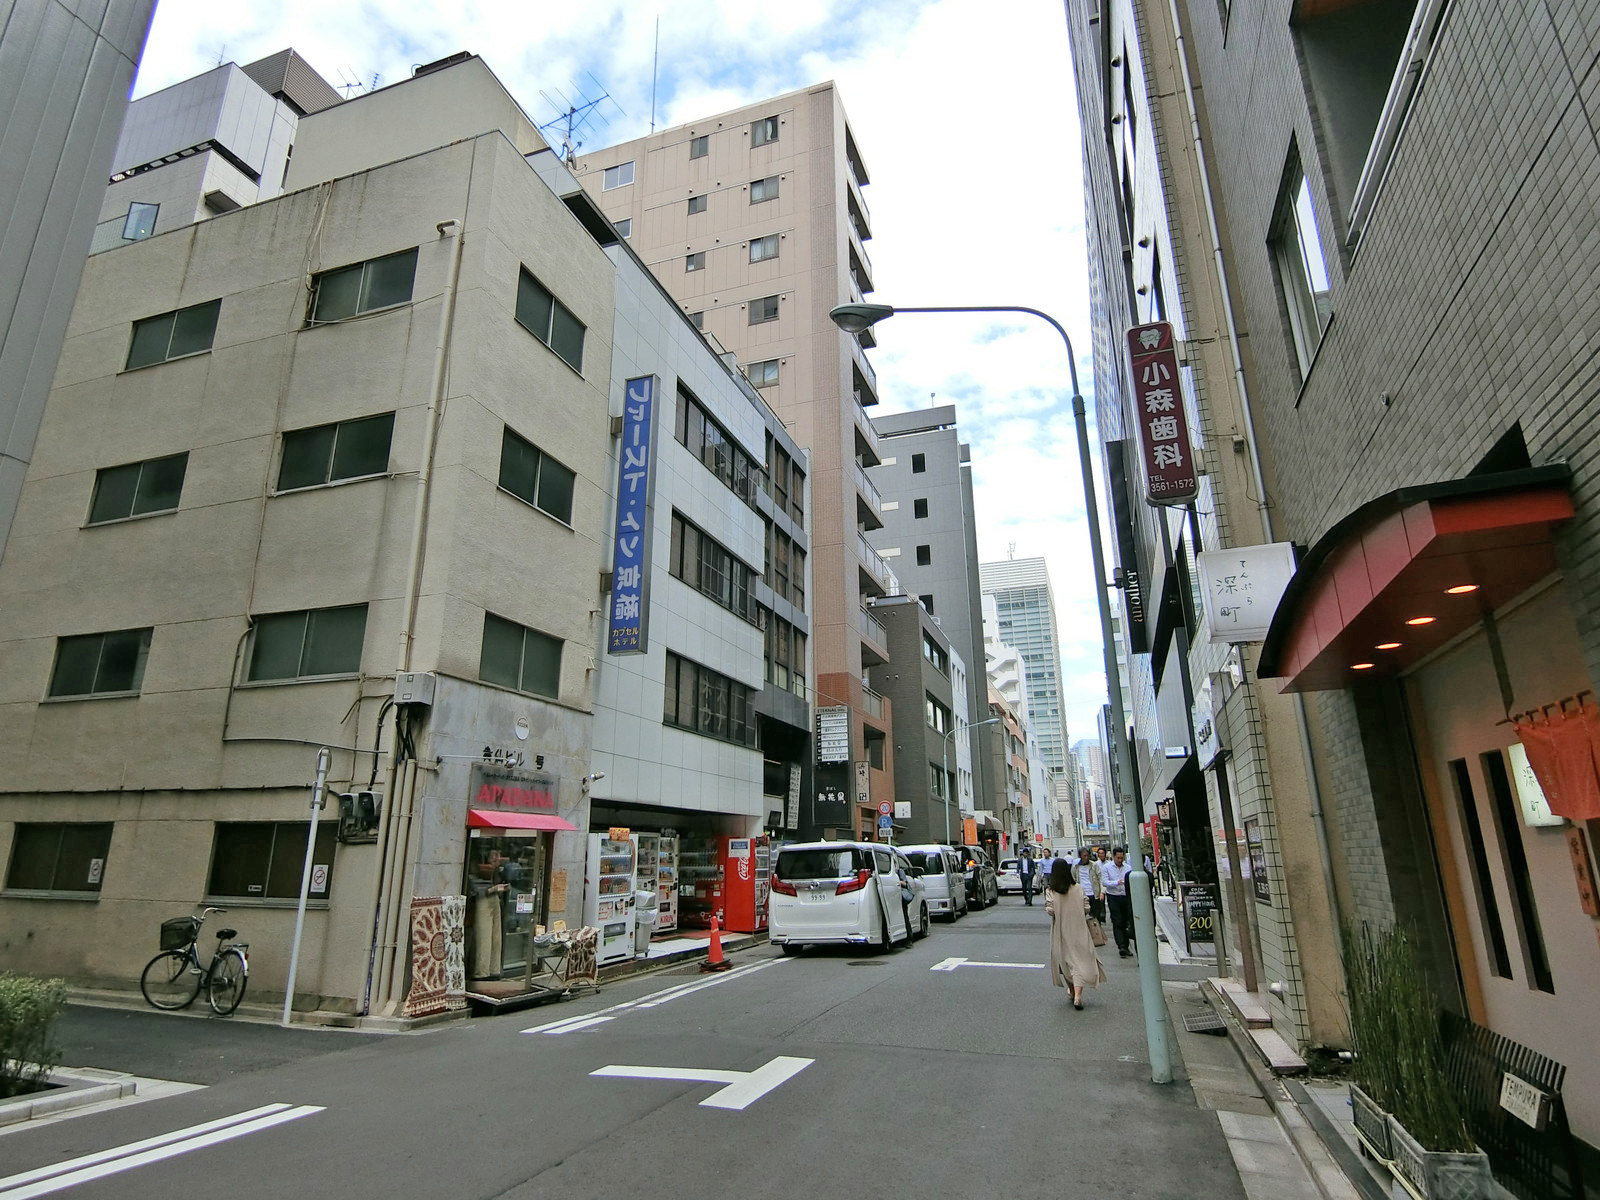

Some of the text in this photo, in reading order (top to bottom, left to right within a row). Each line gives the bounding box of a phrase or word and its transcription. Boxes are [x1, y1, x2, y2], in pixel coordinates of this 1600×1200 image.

[1142, 361, 1184, 470] 小森歯科
[1150, 479, 1195, 493] 3561-1572
[1124, 569, 1144, 624] another
[1215, 575, 1241, 623] 深町
[1239, 560, 1254, 606] てんぷら
[612, 627, 640, 639] カプセル
[612, 637, 638, 648] ホテル
[1505, 1077, 1537, 1111] TEMPURA
